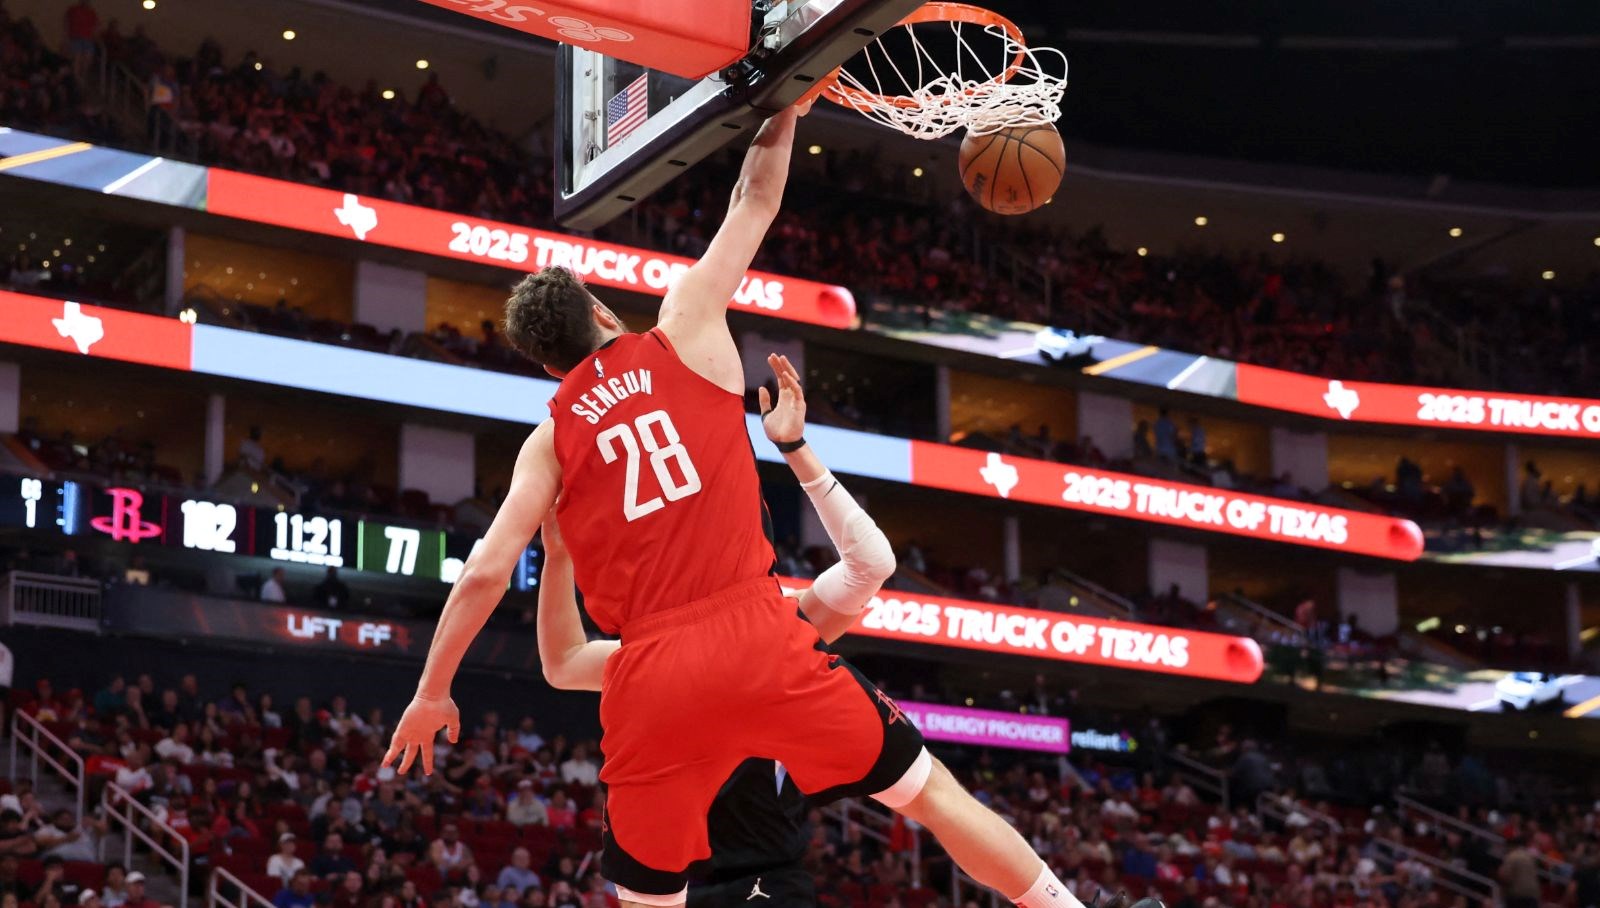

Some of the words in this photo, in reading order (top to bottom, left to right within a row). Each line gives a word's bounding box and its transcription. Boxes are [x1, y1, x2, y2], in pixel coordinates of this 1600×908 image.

[448, 222, 529, 263] 2025
[533, 237, 641, 284] TRUCK
[570, 368, 653, 425] SENGUN
[1416, 393, 1486, 424] 2025
[1487, 398, 1581, 431] TRUCK
[596, 409, 702, 522] 28
[275, 512, 342, 557] 11:21
[1062, 472, 1131, 510] 2025
[1133, 483, 1226, 525] TRUCK
[1226, 499, 1266, 530] OF
[1267, 505, 1349, 545] TEXAS
[384, 525, 421, 576] 77
[861, 595, 941, 637] 2025
[943, 606, 1049, 650] TRUCK
[1051, 621, 1098, 655] OF
[1098, 627, 1189, 668] TEXAS
[925, 712, 988, 737] ENERGY
[988, 719, 1064, 744] PROVIDER
